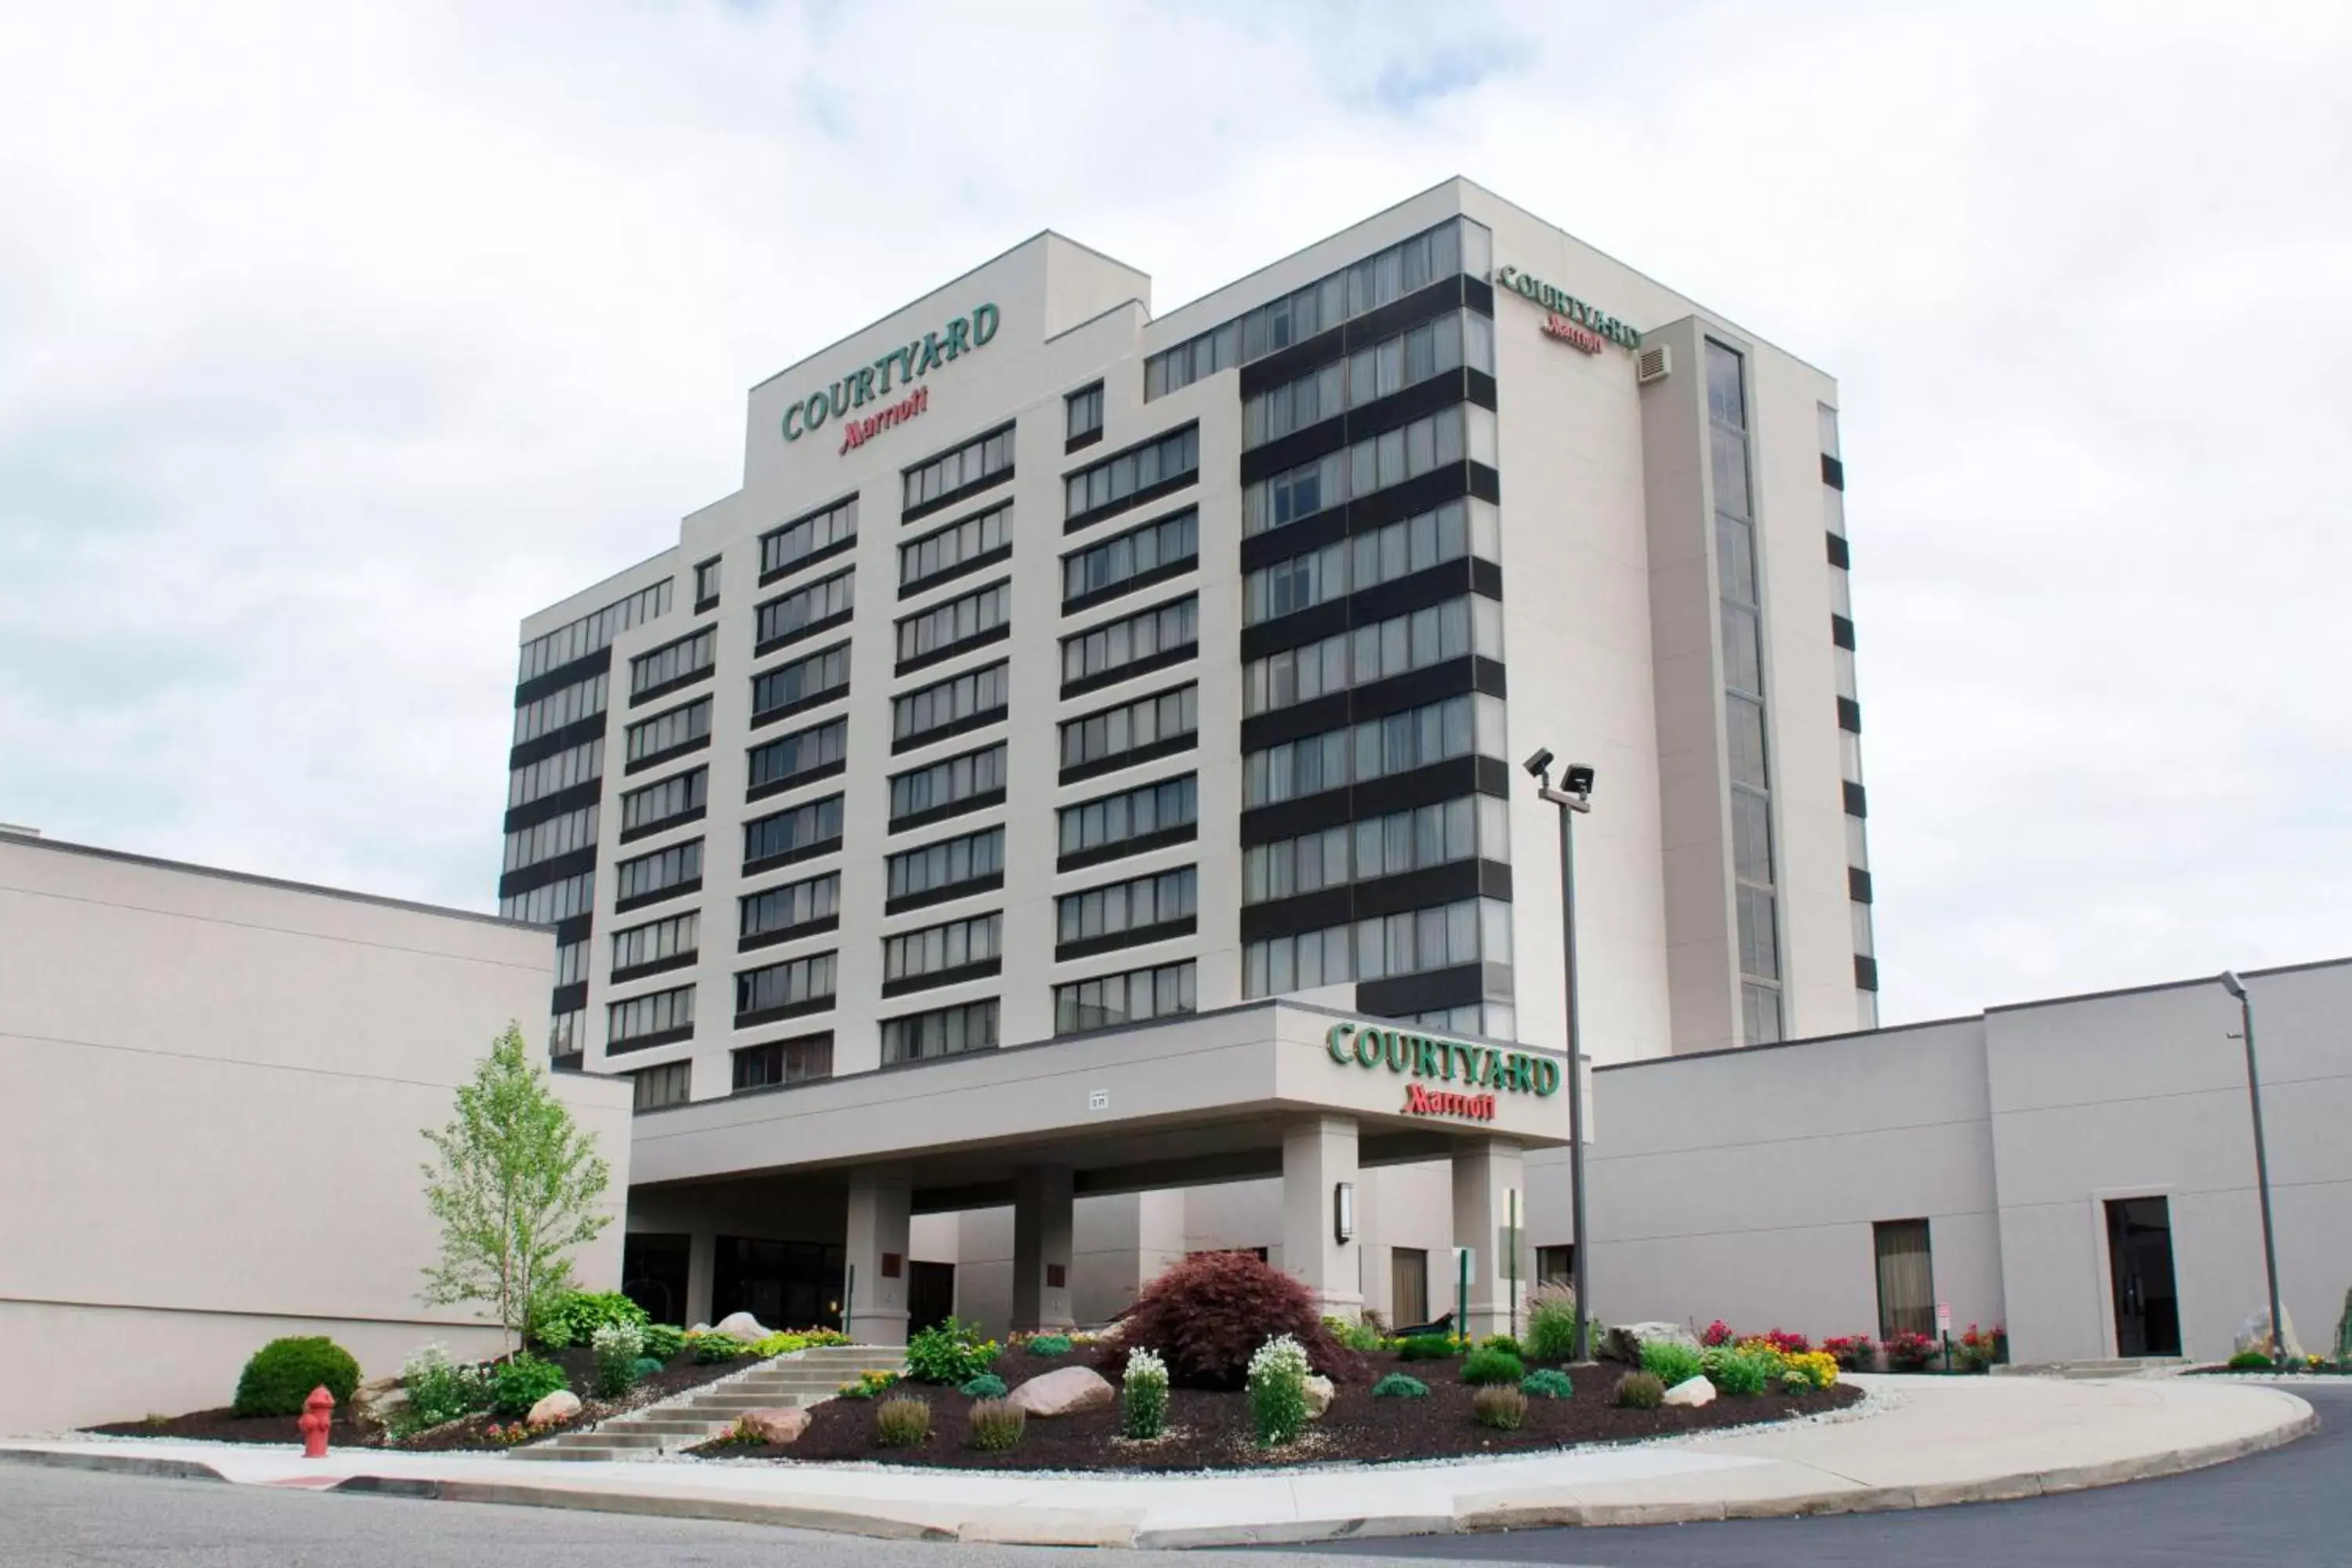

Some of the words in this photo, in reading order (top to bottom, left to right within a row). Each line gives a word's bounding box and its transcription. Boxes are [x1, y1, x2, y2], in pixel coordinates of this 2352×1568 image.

[1499, 265, 1642, 350] COURTYARD
[1542, 314, 1602, 355] Marriott
[782, 302, 1000, 441] COURTYARD
[839, 385, 928, 456] Marriott
[1326, 1022, 1560, 1096] COURTYARD
[1401, 1083, 1495, 1120] Marriott
